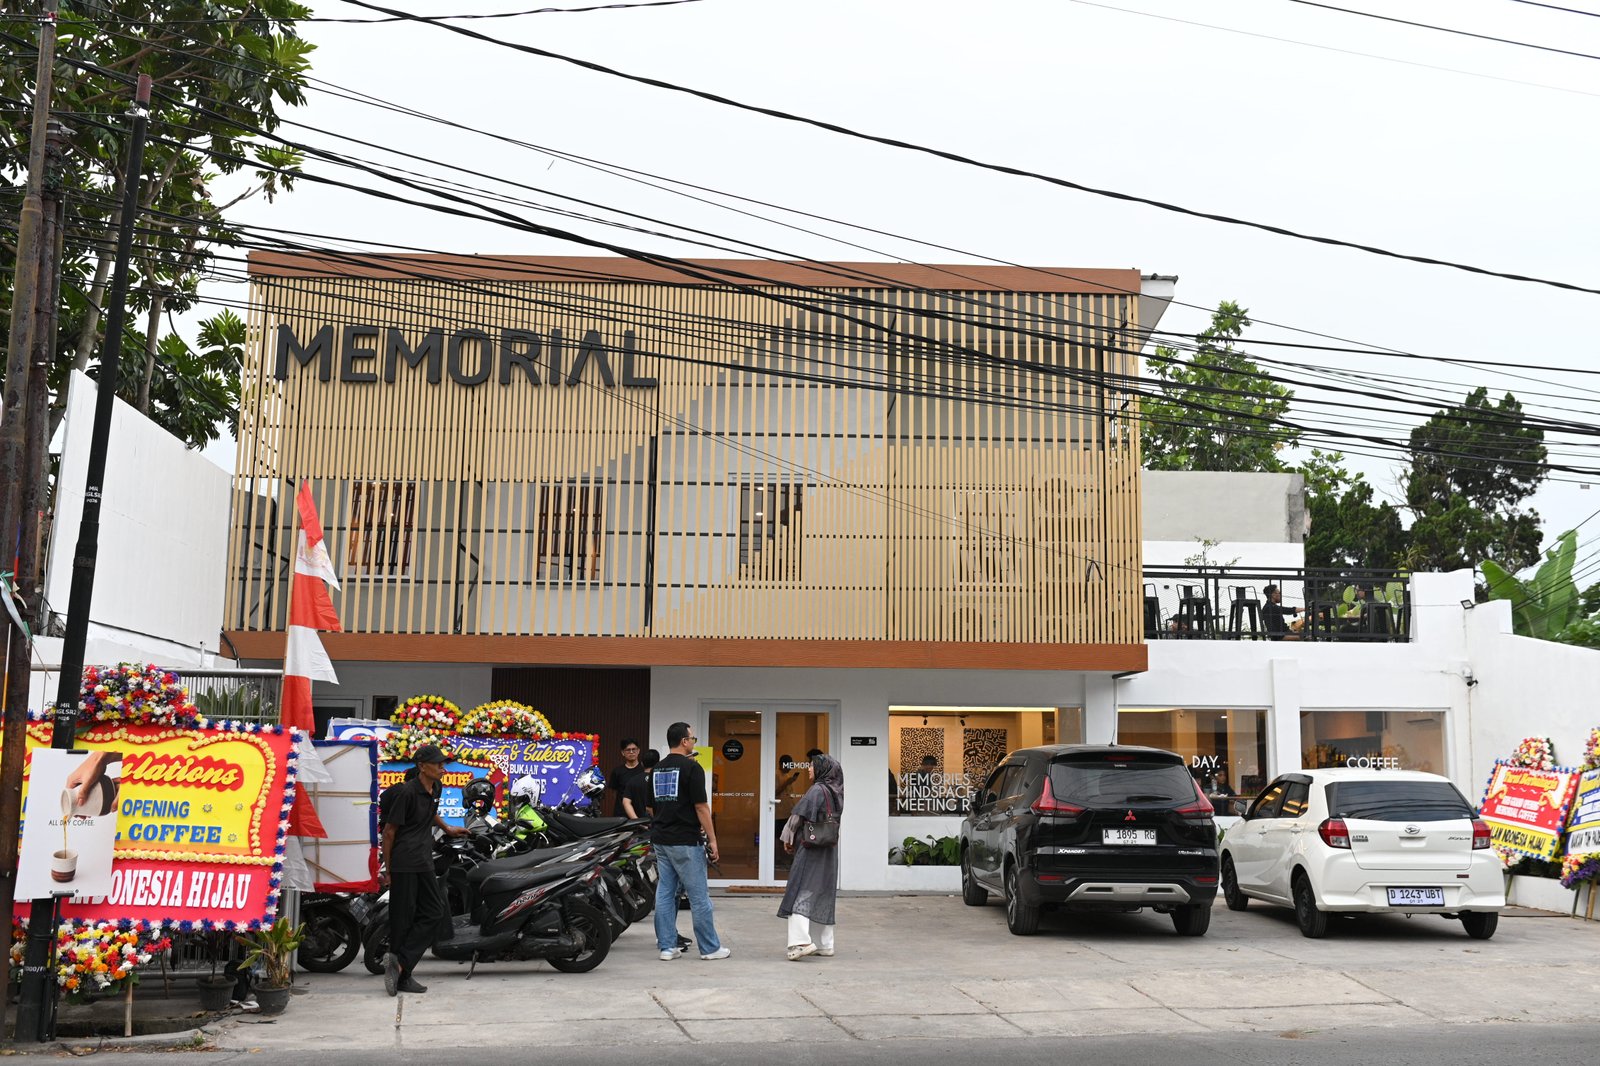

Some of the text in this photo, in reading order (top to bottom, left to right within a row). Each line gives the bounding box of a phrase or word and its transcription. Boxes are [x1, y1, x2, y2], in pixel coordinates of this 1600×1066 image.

[275, 323, 657, 388] MEMORIAL
[523, 743, 575, 763] Sukses
[509, 764, 539, 775] BUKAAN
[782, 761, 810, 769] MEMOR
[897, 772, 971, 786] MEMORIES
[121, 798, 191, 818] OPENING
[896, 798, 957, 811] MEETING
[128, 824, 222, 843] COFFEE
[1104, 830, 1155, 839] A 1895 RG
[68, 869, 251, 909] ONESIA HIJAU
[1391, 890, 1440, 899] D 1243 UBT
